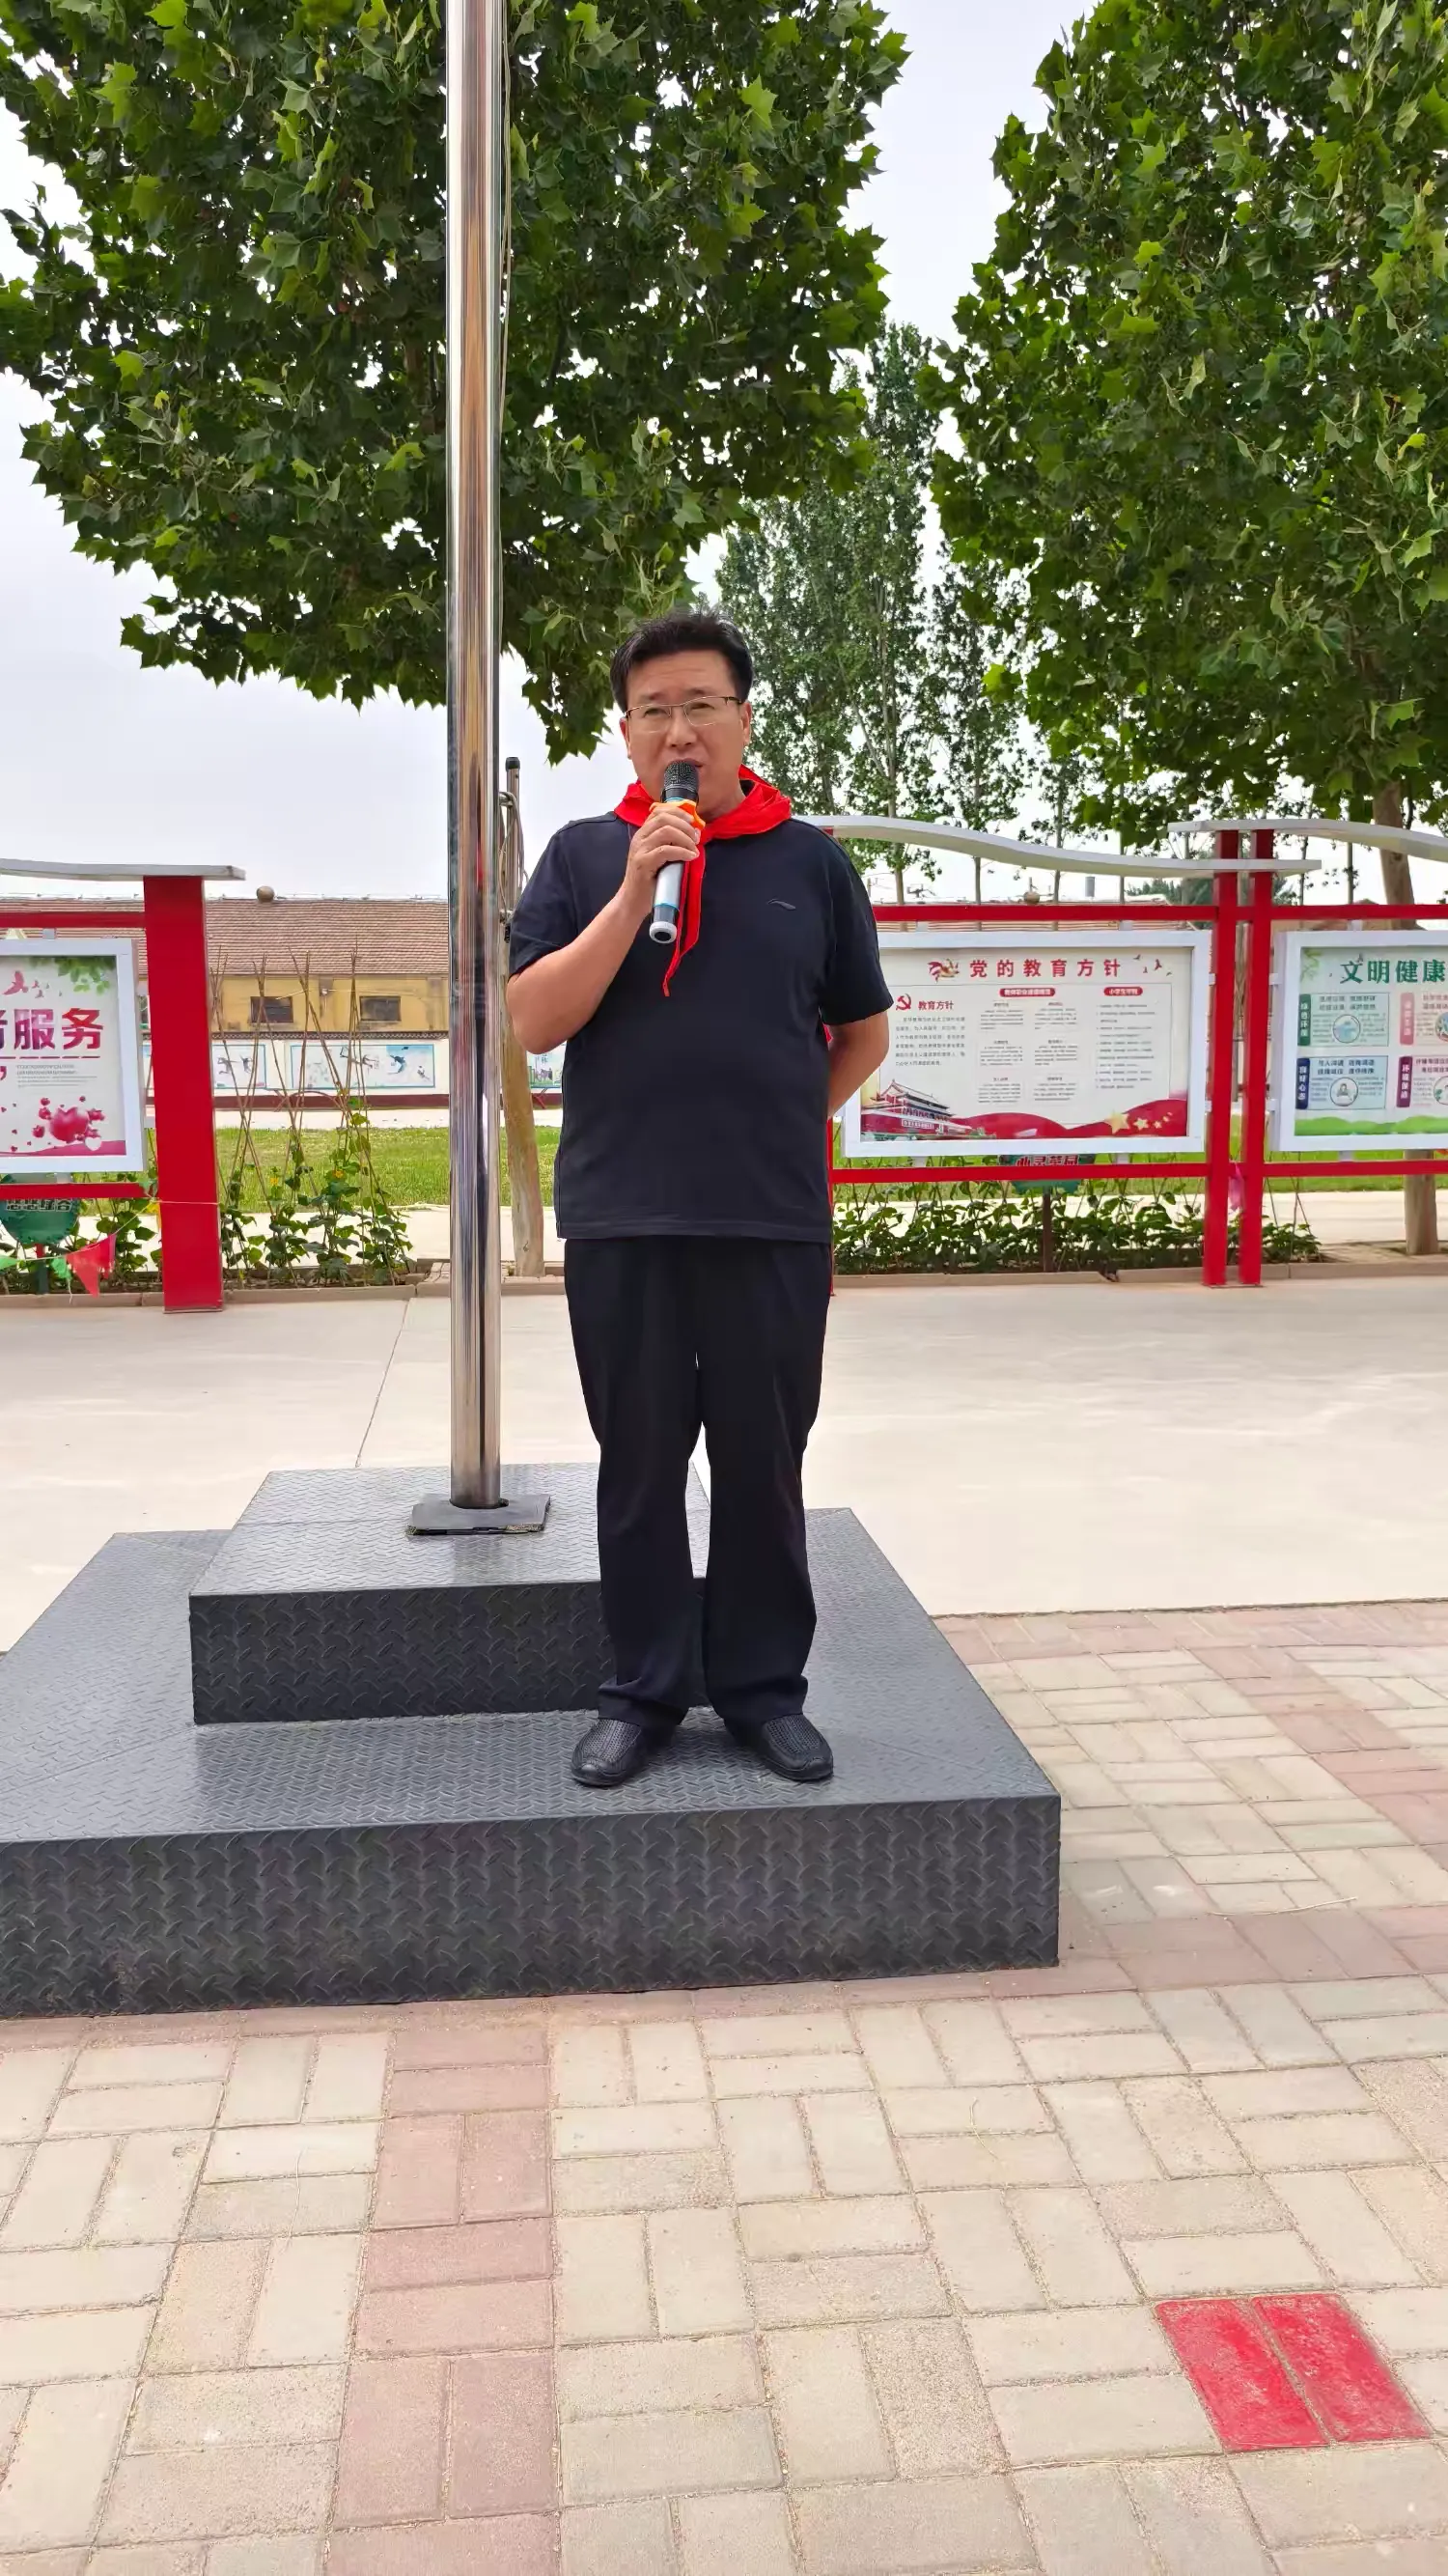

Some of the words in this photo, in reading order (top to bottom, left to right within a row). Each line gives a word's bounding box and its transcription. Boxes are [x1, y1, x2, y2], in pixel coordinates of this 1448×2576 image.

[969, 958, 1122, 978] 党的教育方针
[1339, 958, 1446, 985] 文明健康
[917, 999, 954, 1011] 教育方针
[0, 1007, 104, 1050] 服务
